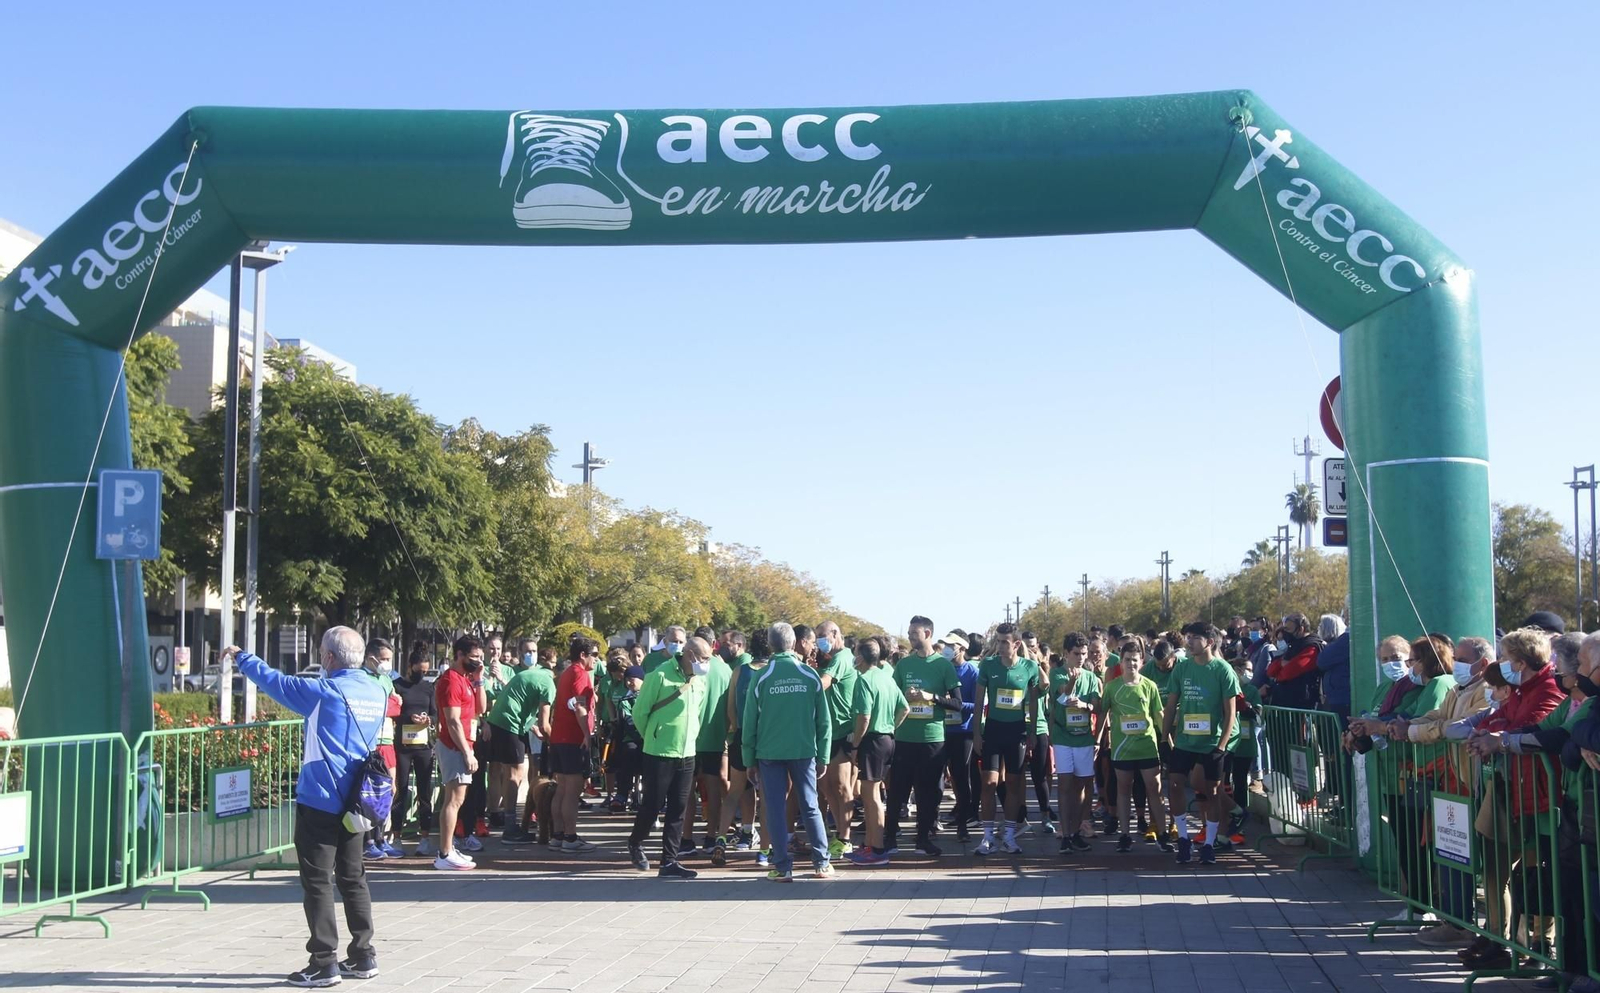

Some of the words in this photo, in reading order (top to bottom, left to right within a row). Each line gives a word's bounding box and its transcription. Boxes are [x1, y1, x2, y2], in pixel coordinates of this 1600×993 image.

[656, 113, 882, 163] aecc
[72, 162, 203, 290] aecc
[661, 186, 730, 216] en
[735, 164, 932, 215] marcha
[115, 256, 154, 289] Contra
[154, 241, 165, 257] el
[164, 209, 203, 245] Cáncer
[1276, 178, 1426, 292] aecc
[1279, 219, 1320, 254] Contra
[1319, 253, 1336, 264] el
[1333, 260, 1377, 294] Cáncer
[114, 480, 145, 517] P
